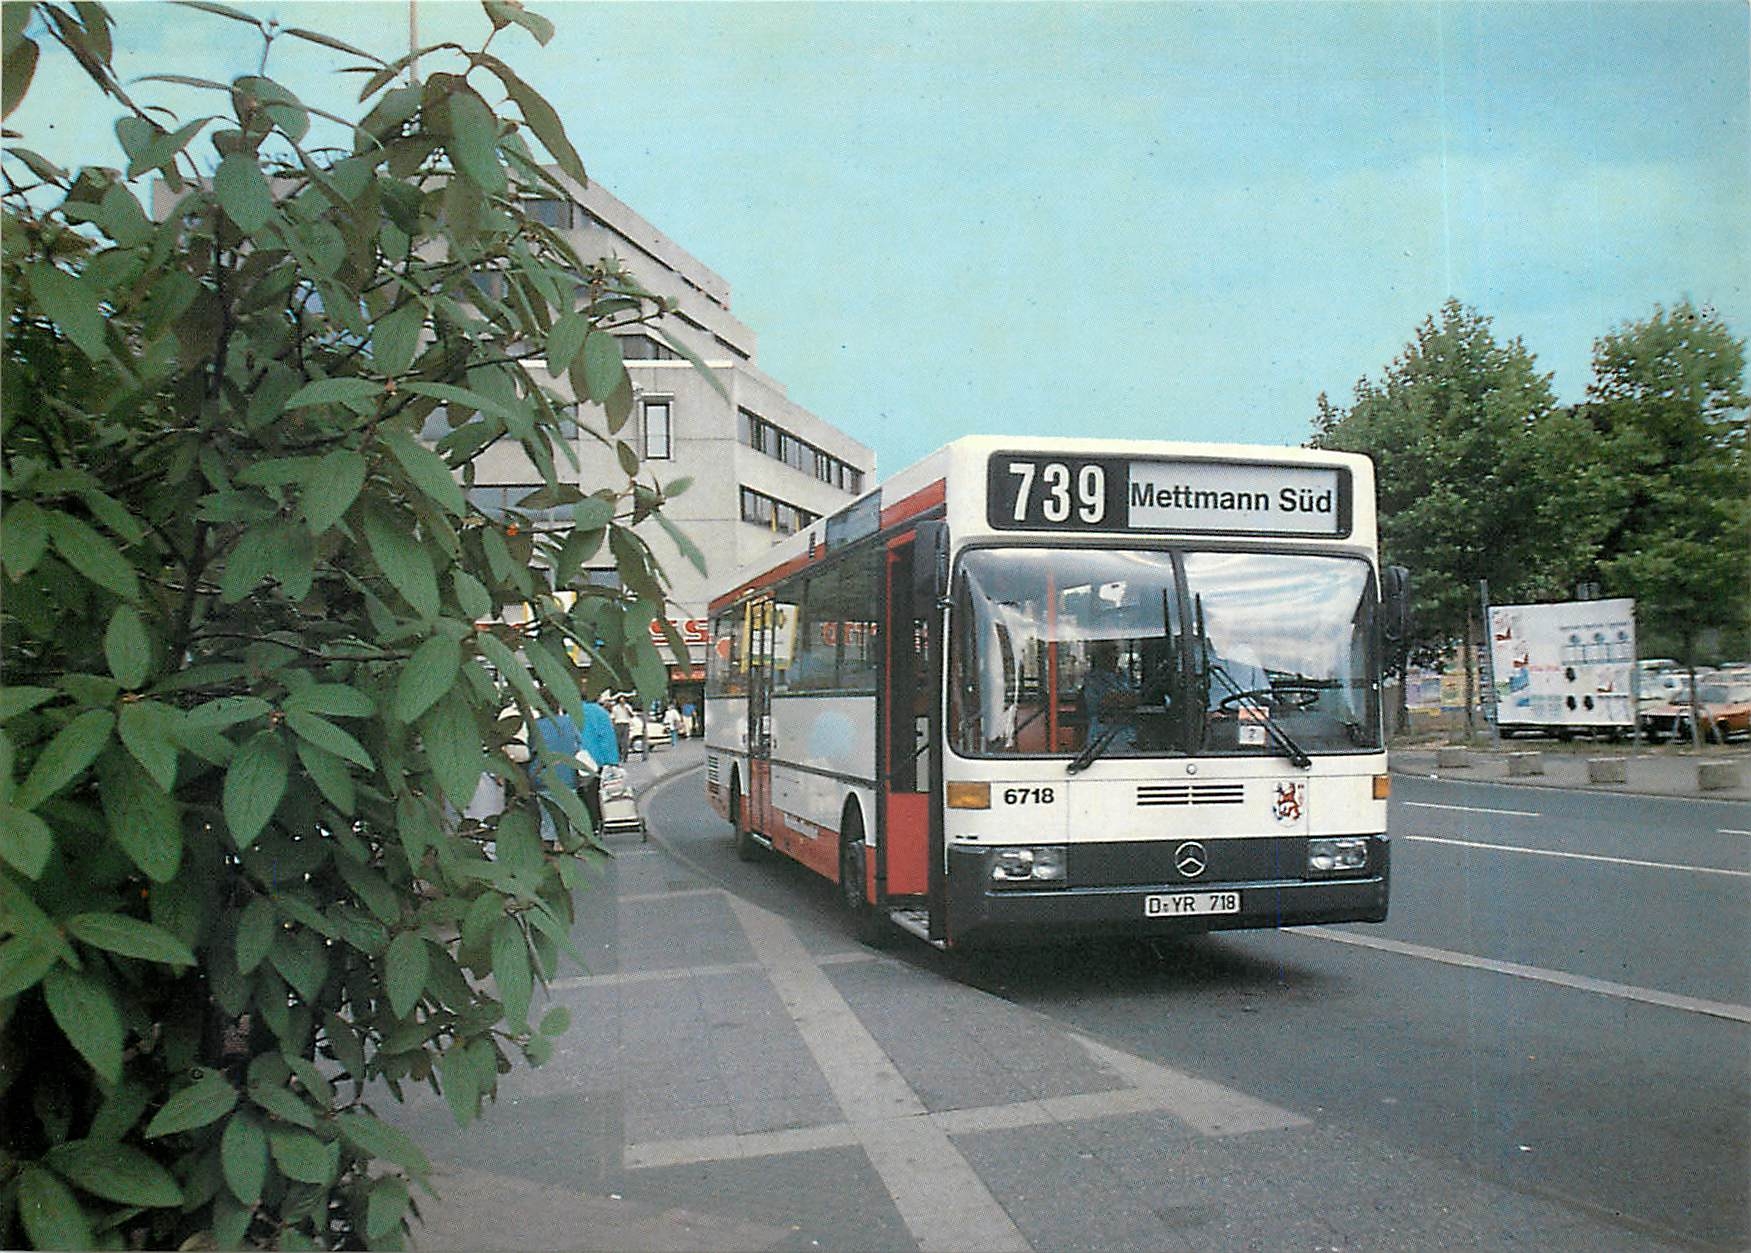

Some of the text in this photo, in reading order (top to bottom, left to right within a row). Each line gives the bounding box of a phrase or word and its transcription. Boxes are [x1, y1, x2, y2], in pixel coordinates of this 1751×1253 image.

[1009, 462, 1105, 523] 739
[1131, 482, 1333, 514] Mettmann Süd
[1004, 787, 1054, 805] 6718
[1210, 894, 1235, 911] 718
